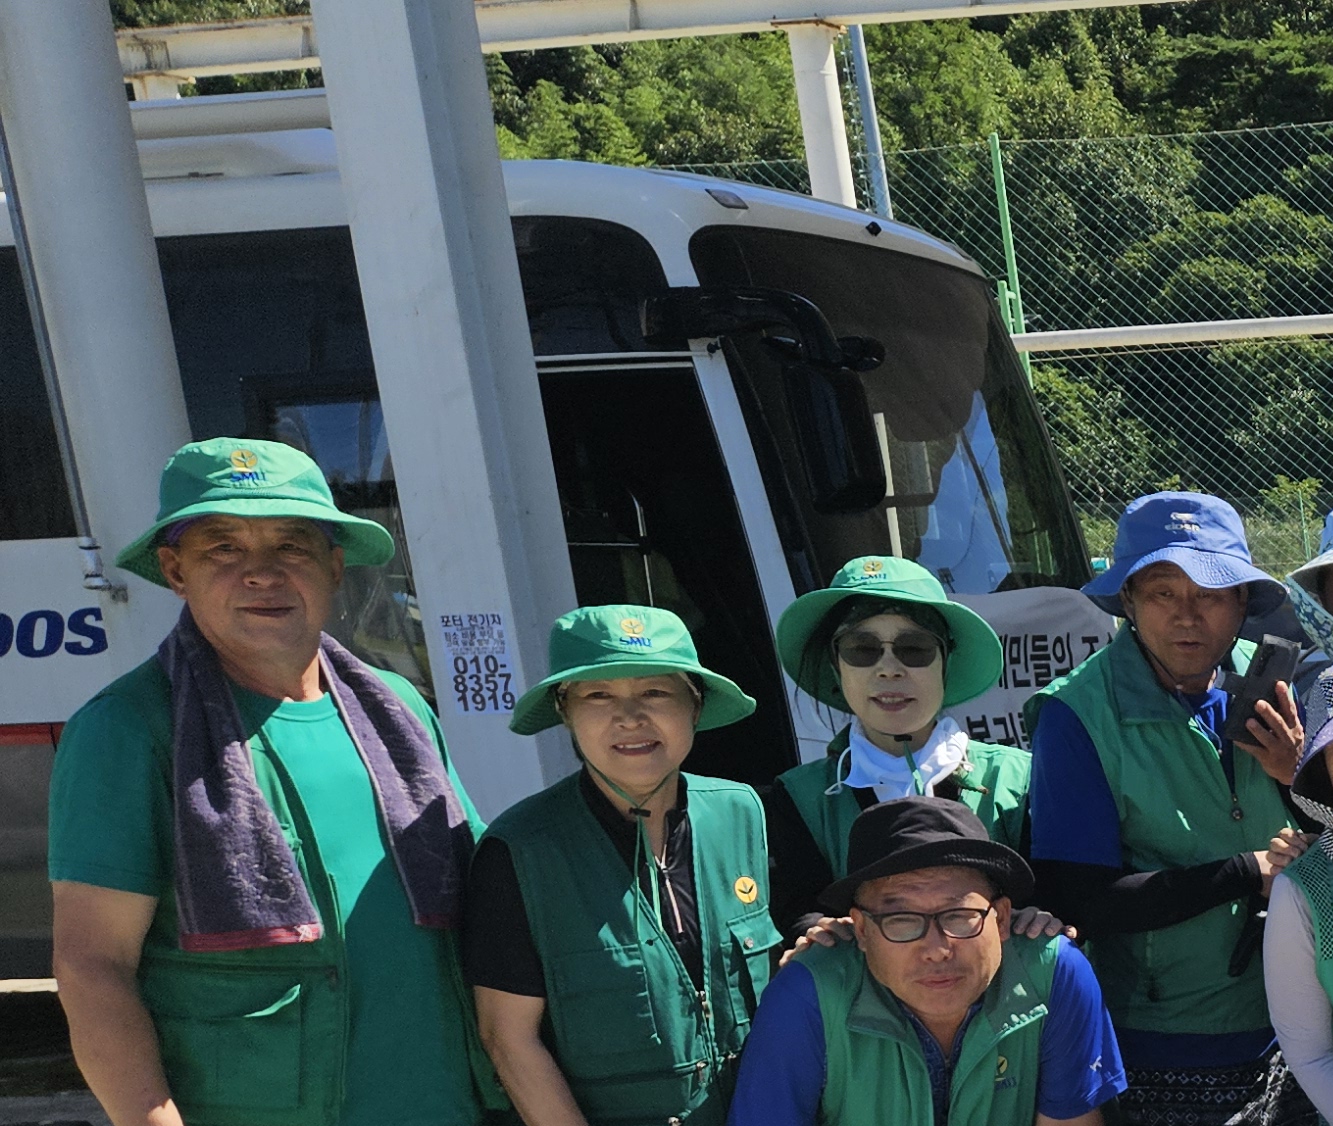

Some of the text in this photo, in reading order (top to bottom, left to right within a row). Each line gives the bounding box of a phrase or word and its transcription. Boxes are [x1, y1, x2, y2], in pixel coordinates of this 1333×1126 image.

[0, 606, 109, 658] OS
[441, 614, 464, 628] 포터
[453, 654, 507, 675] 010-
[453, 672, 512, 694] 8357
[457, 690, 516, 712] 1919
